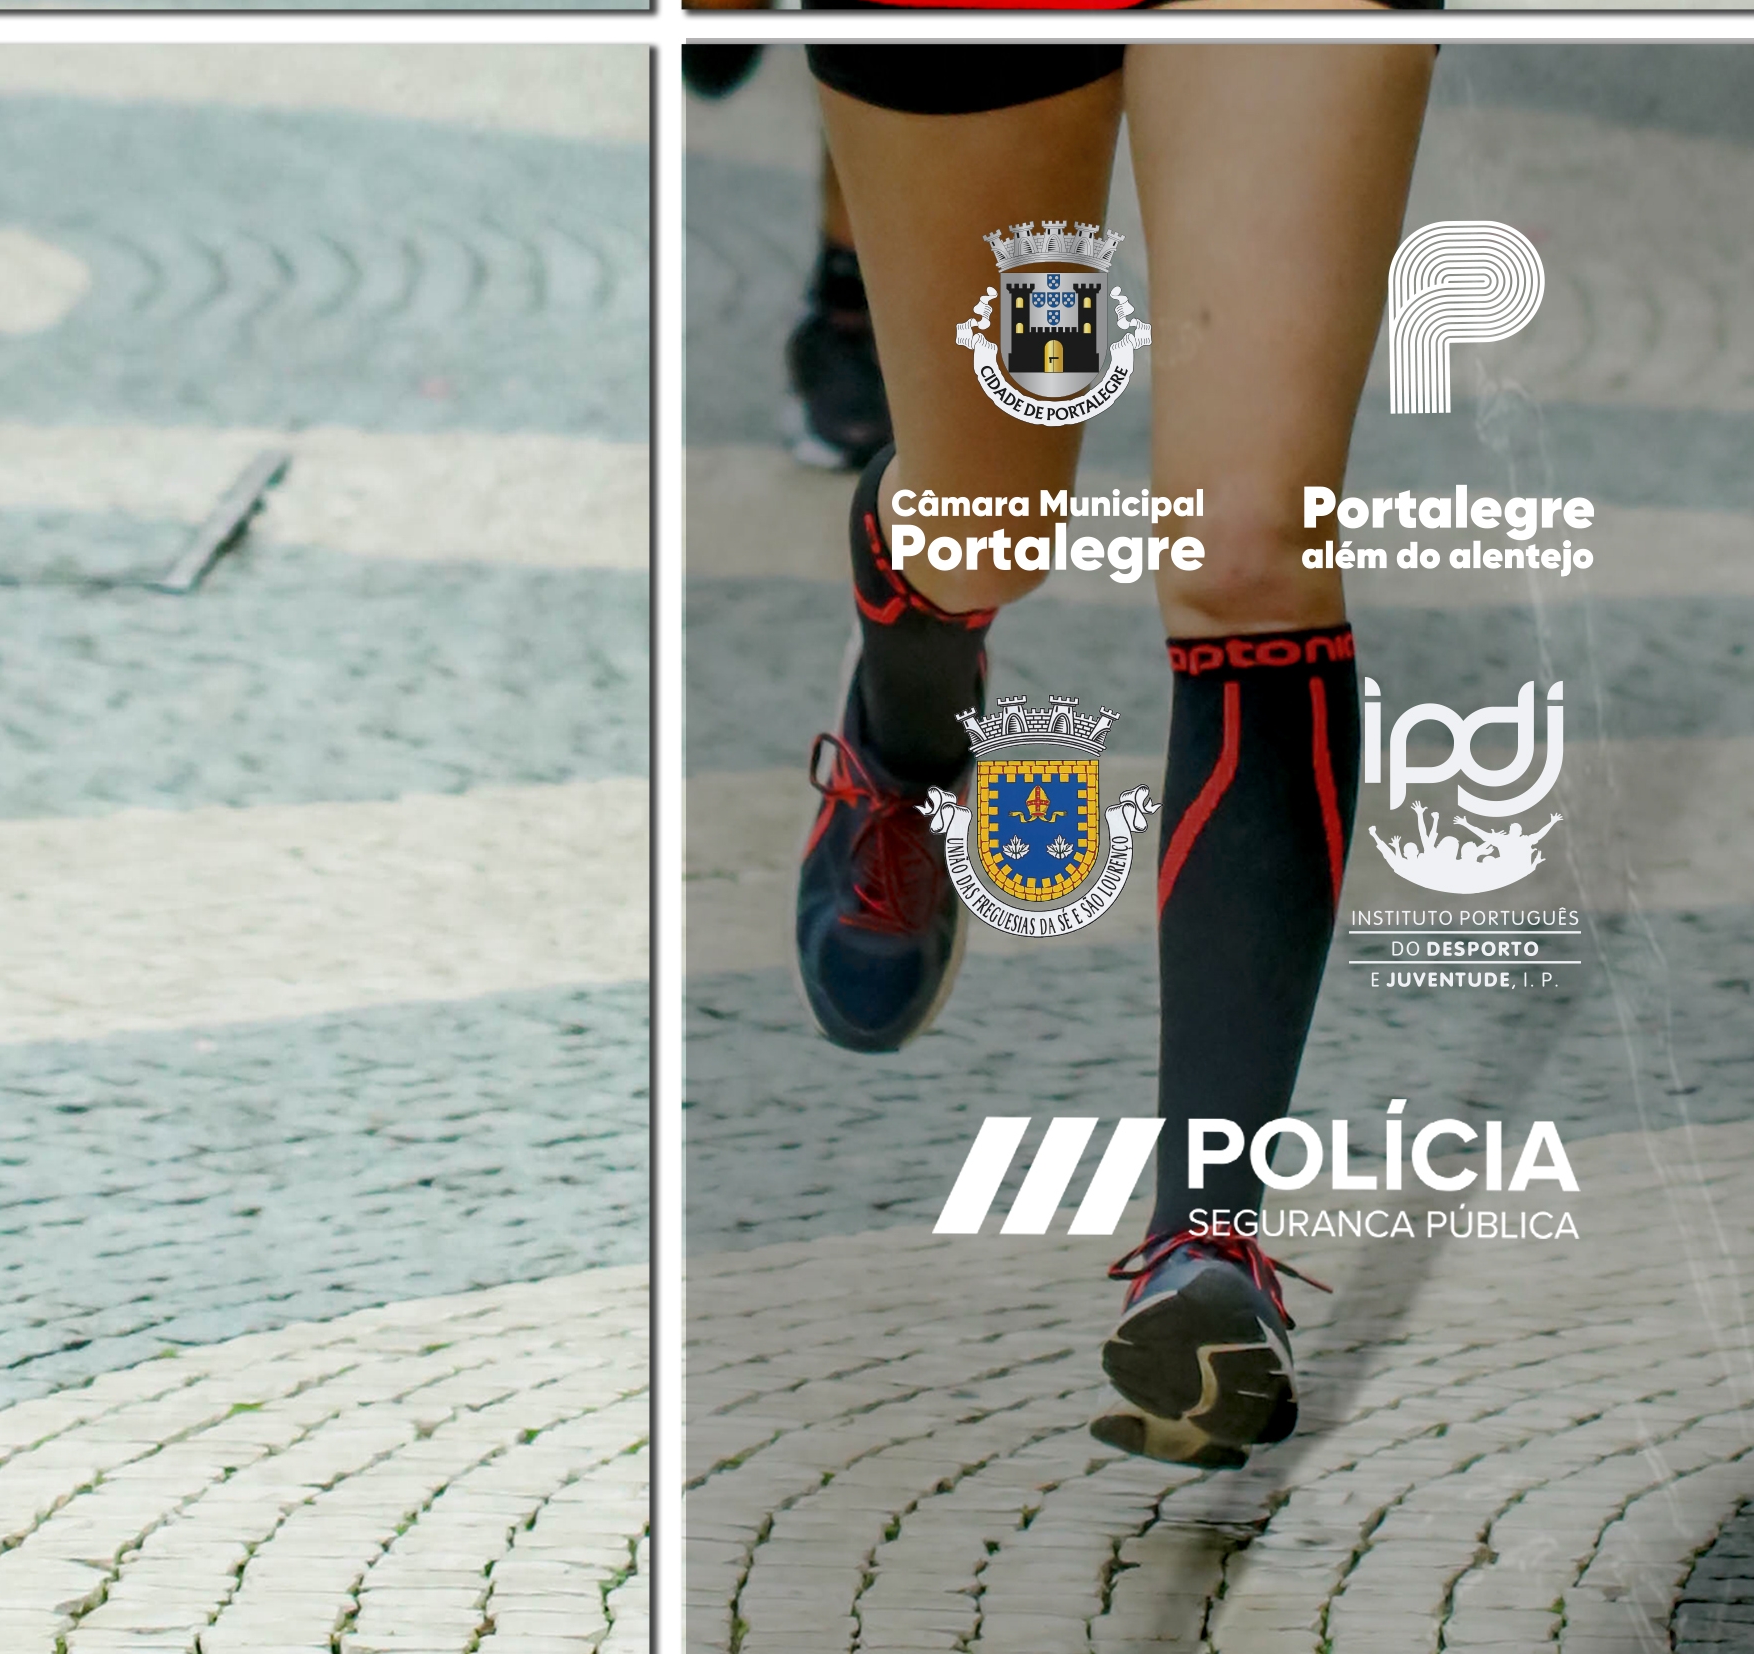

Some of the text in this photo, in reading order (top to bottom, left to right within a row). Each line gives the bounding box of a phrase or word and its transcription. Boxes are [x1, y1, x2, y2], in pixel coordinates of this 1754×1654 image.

[980, 365, 1128, 421] CIDADE DE PORTALEGRE
[891, 488, 1204, 525] Câmara Municipal
[1303, 485, 1595, 541] Portalegre
[891, 525, 1205, 584] Portalegre
[1302, 540, 1594, 578] além do alentejo
[1364, 676, 1564, 818] ipdj
[947, 835, 1133, 935] UNIÃO DAS FREGUESIAS DA SÉ E SÃO LOURENÇO
[1352, 906, 1579, 926] INSTITUTO PORTUGUÊS
[1392, 941, 1539, 957] DO DESPORTO
[1371, 972, 1380, 987] E
[1386, 972, 1516, 990] JUVENTUDE,
[1188, 1098, 1581, 1192] POLÍCIA
[1188, 1203, 1580, 1240] SEGURANCA PÚBLICA
